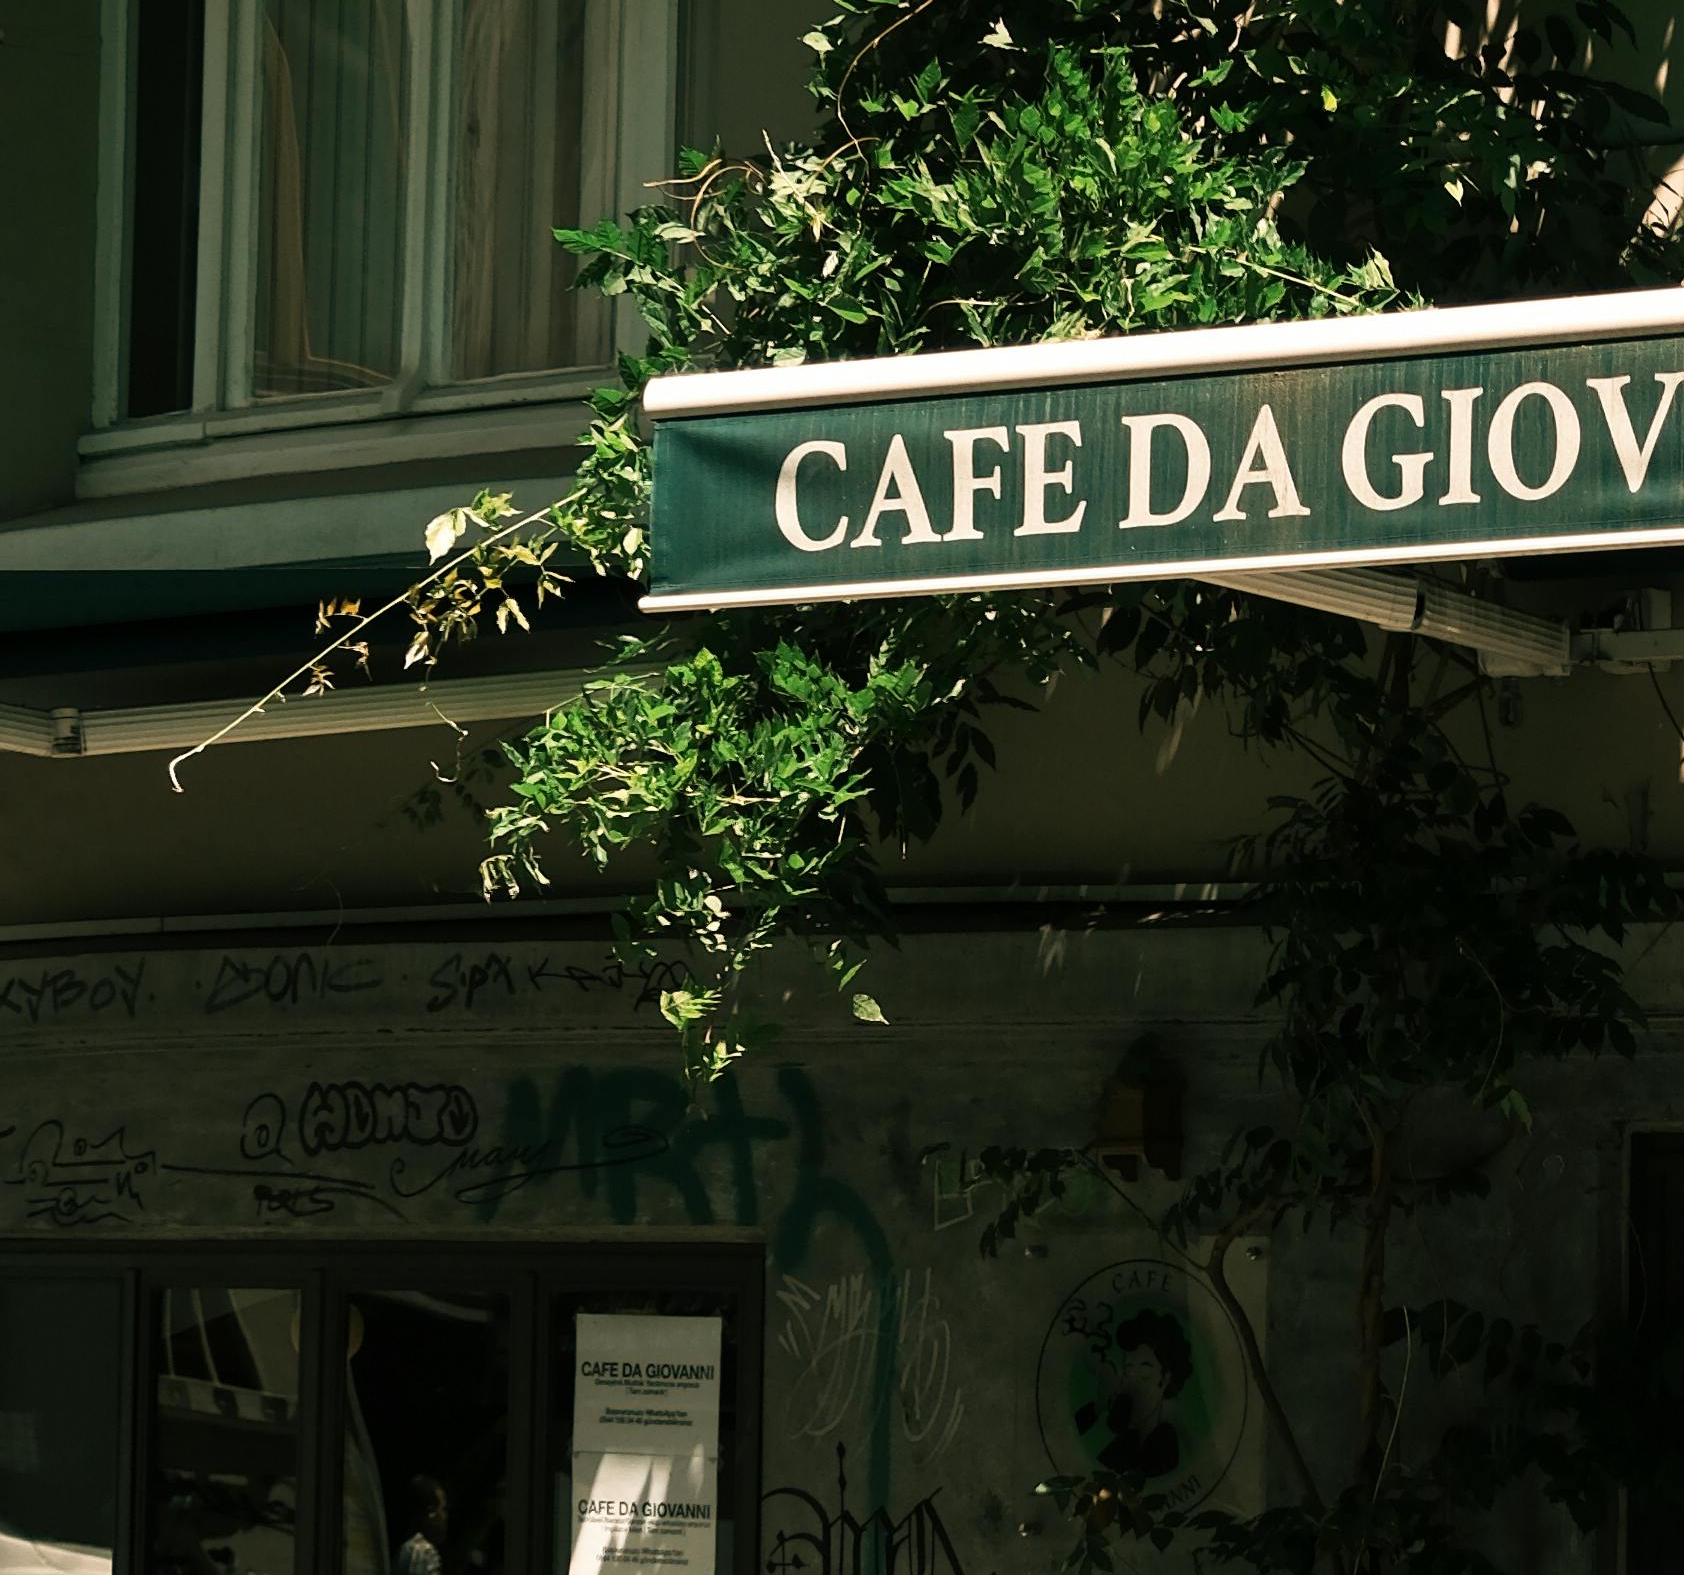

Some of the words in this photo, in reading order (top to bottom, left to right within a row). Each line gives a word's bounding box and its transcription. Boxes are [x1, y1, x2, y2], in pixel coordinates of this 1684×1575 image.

[776, 421, 1086, 552] CAFE
[1119, 403, 1311, 530] DA
[1111, 1270, 1171, 1294] CAFE
[580, 1360, 619, 1378] CAFE
[622, 1363, 642, 1378] DA
[645, 1364, 715, 1380] GIOVANNI
[577, 1499, 615, 1516] CAFE
[619, 1501, 639, 1517] DA
[642, 1501, 711, 1519] GIOVANNI
